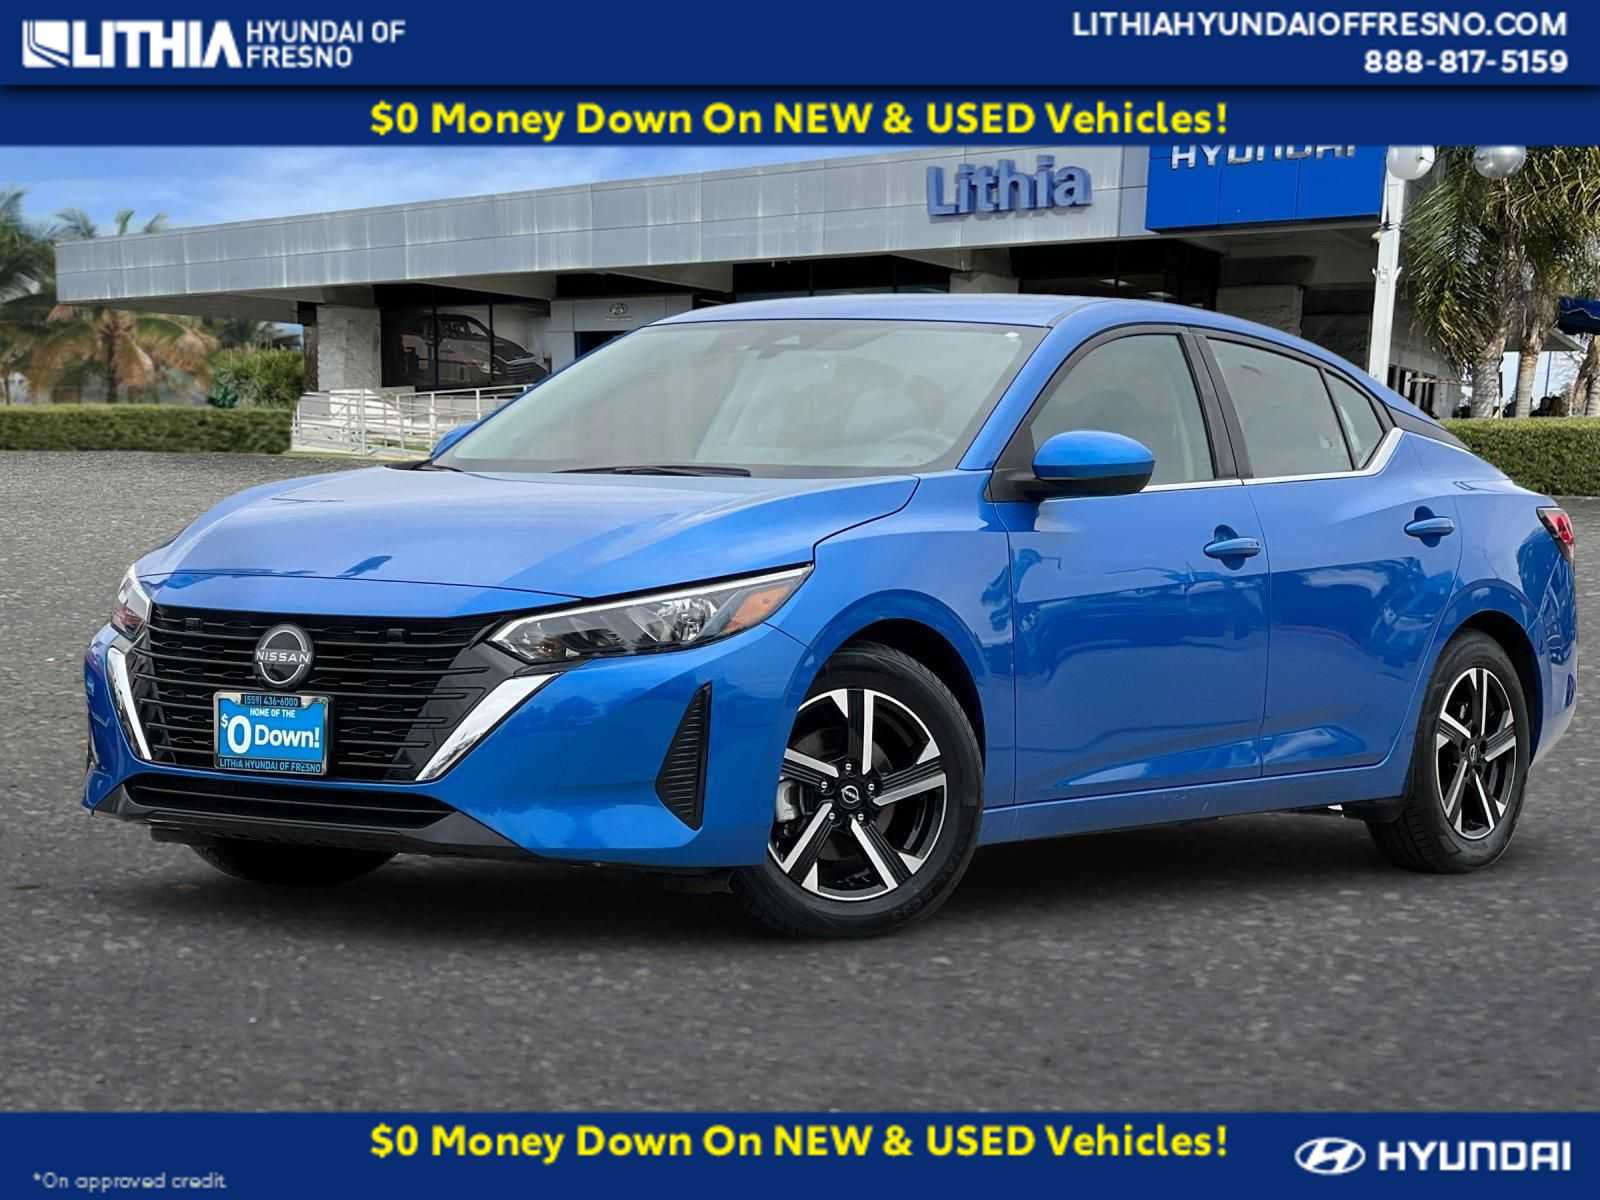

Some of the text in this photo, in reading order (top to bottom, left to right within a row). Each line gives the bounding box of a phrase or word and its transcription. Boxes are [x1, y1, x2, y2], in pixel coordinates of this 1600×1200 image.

[926, 155, 1093, 217] Lithia
[256, 651, 311, 664] NISSAN
[263, 697, 298, 707] 436-6000
[249, 708, 296, 719] HOME OF THE
[254, 724, 320, 749] Down!
[219, 758, 321, 773] LITHIA HYUNDAI OF FRESNO
